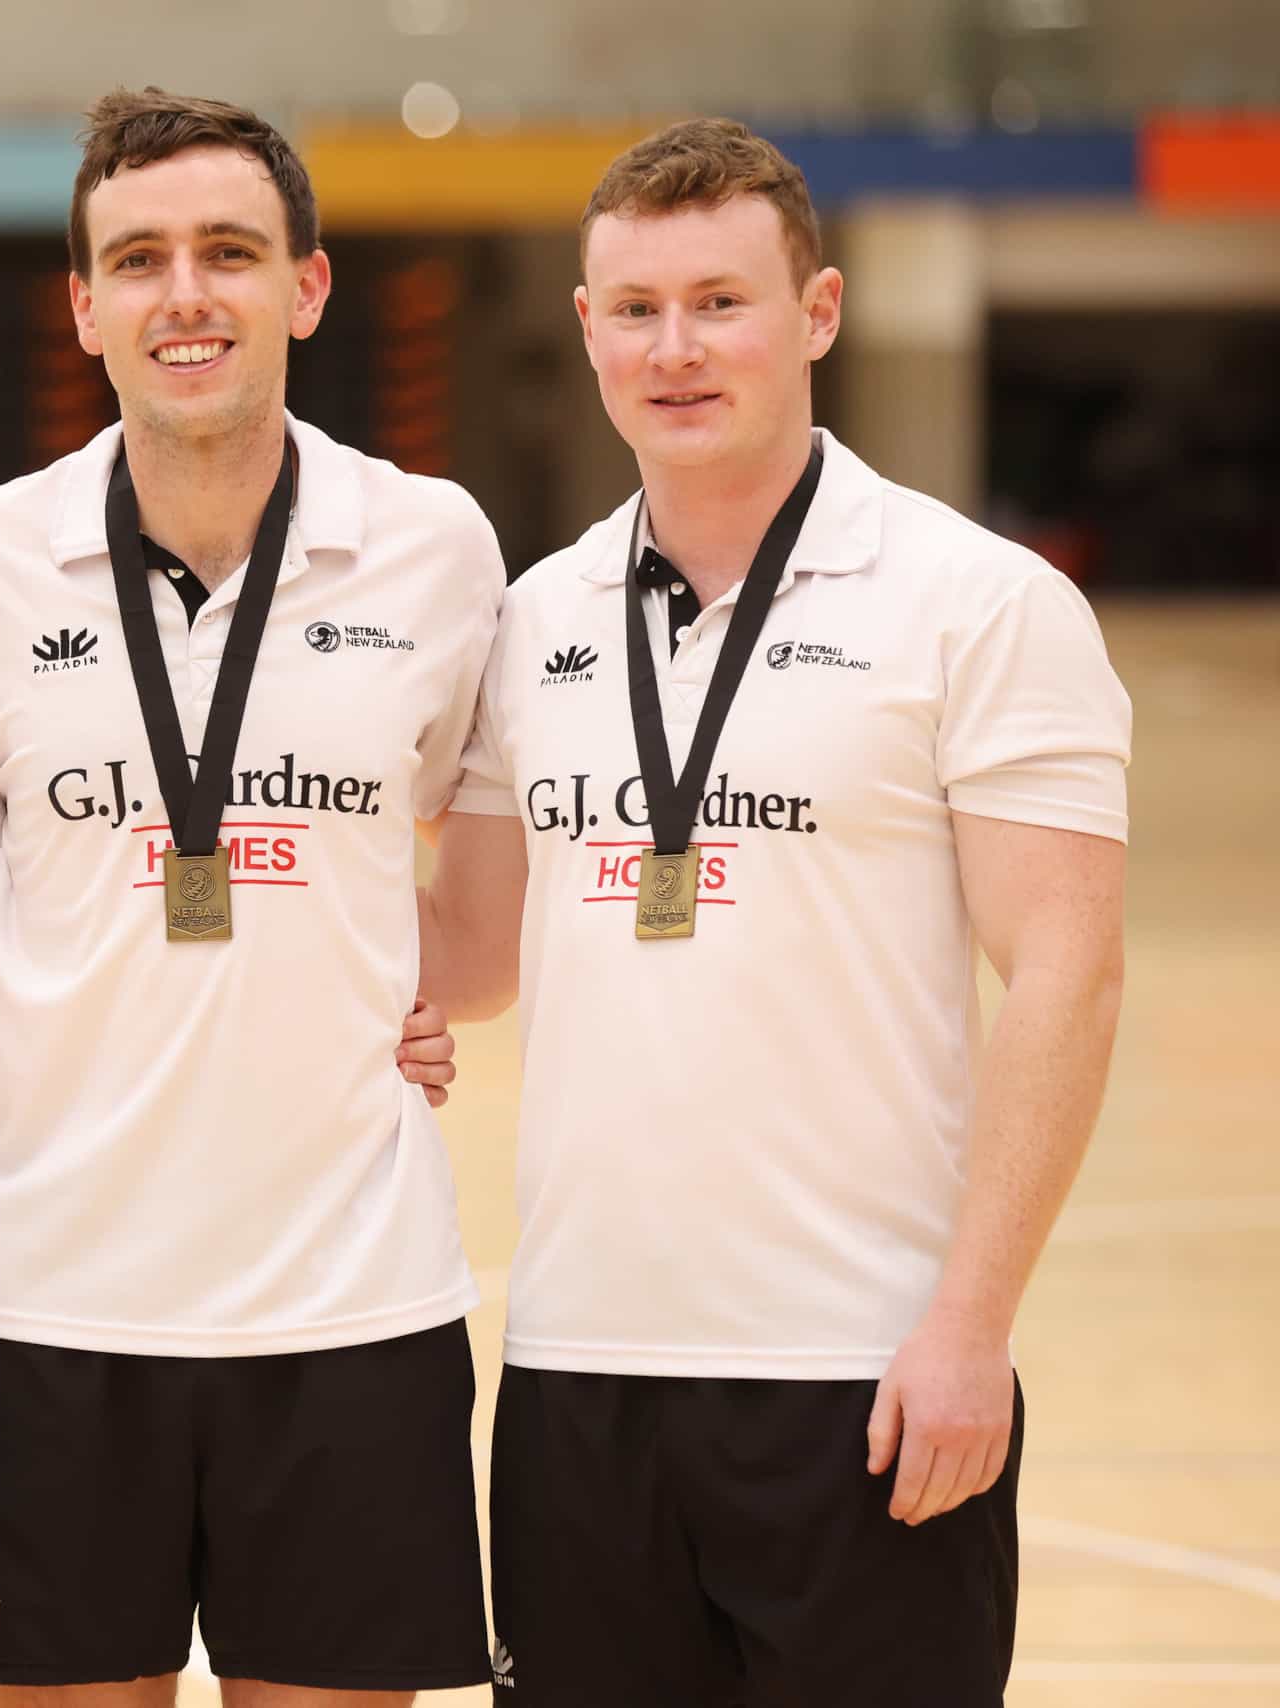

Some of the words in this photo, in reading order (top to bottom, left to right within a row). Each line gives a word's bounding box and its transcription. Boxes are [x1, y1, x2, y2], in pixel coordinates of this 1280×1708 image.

[344, 625, 391, 638] NETBALL
[345, 637, 371, 648] NEW
[372, 638, 415, 651] ZEALAND
[798, 641, 844, 656] NETBALL
[33, 655, 99, 675] PALADIN
[795, 653, 820, 665] NEW
[821, 656, 872, 671] ZEALAND
[540, 671, 594, 688] PALADIN
[47, 759, 143, 830] G.J.
[186, 752, 382, 817] rdner.
[527, 774, 598, 842] G.J.
[614, 772, 818, 834] Gdner.
[147, 837, 297, 873] HMES
[596, 855, 727, 889] HOS
[640, 902, 689, 916] NETBALL
